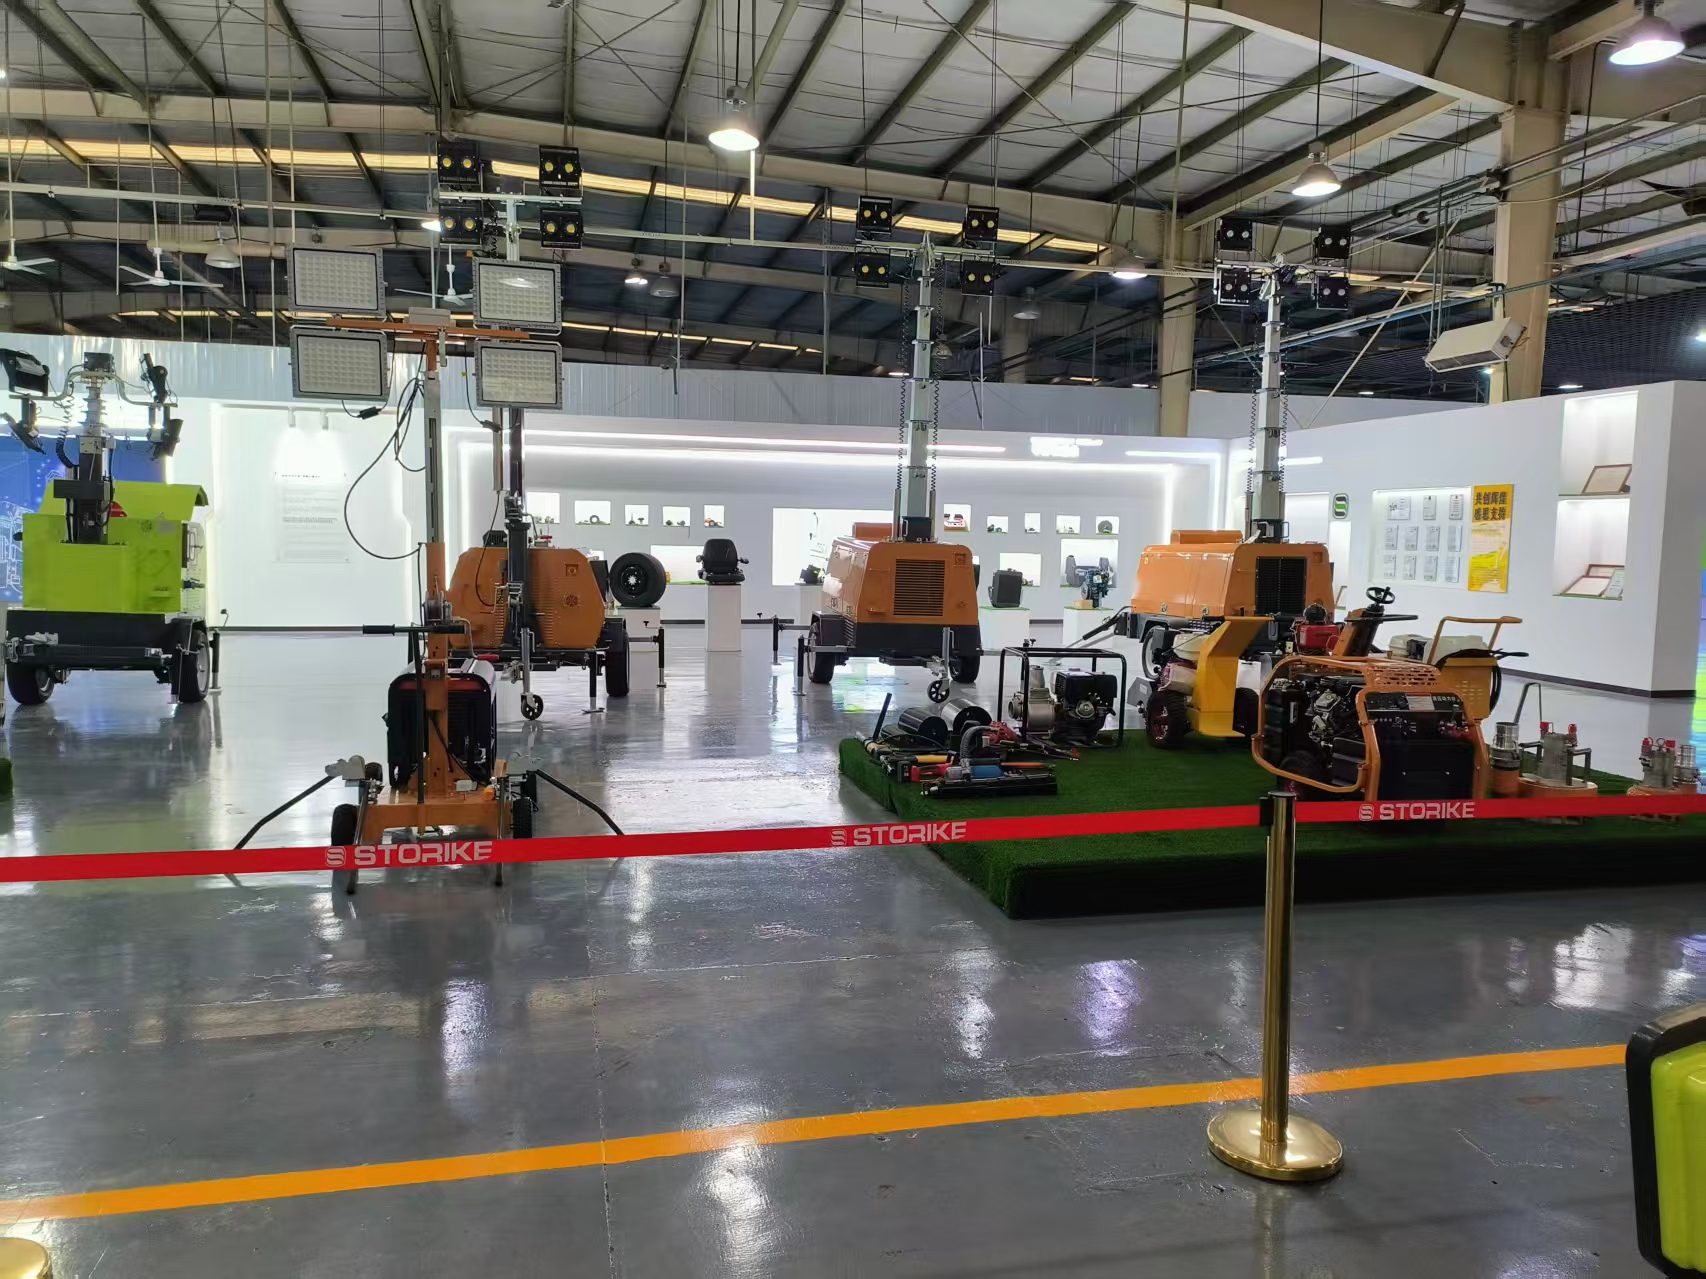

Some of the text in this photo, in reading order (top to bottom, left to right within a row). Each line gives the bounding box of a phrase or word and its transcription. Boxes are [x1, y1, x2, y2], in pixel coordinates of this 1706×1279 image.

[1380, 802, 1475, 820] STORIKE
[853, 821, 967, 846] STORIKE
[354, 841, 493, 866] STORIKE
